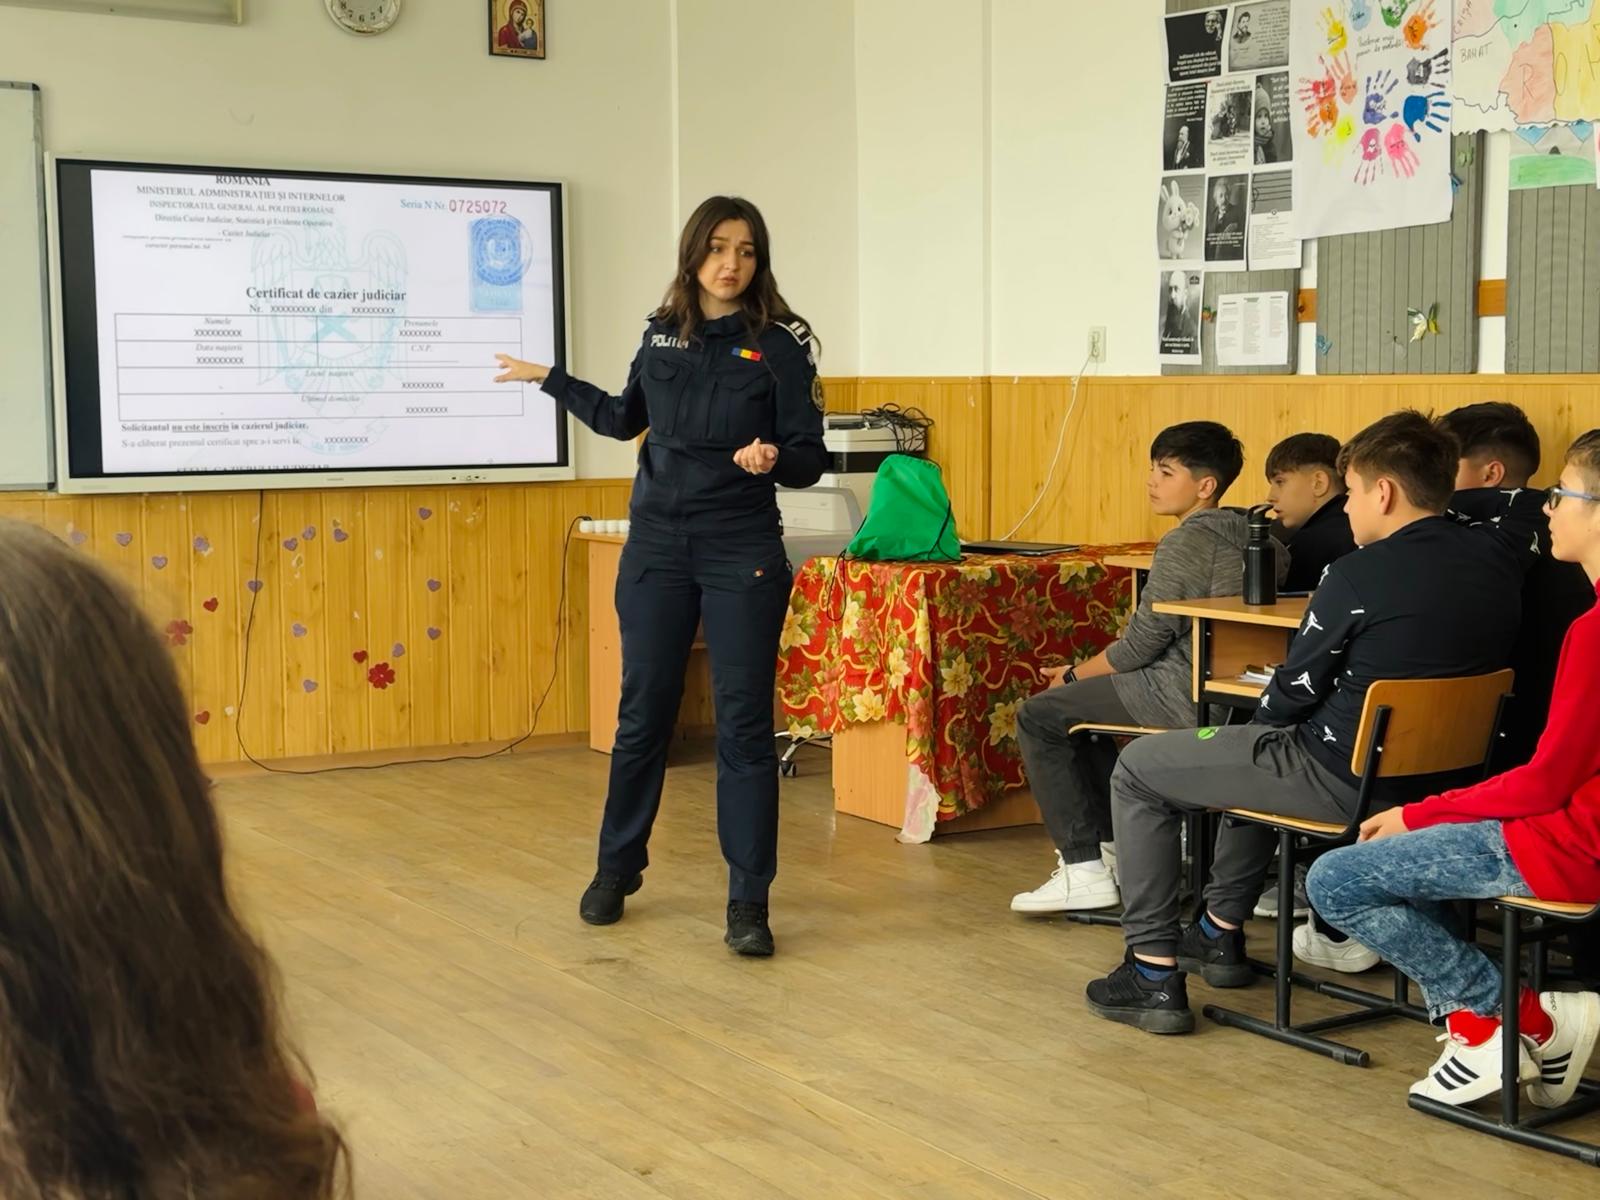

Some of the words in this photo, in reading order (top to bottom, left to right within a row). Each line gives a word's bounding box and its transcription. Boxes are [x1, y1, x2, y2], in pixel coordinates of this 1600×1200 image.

[136, 185, 196, 196] MINISTERUL
[288, 191, 346, 202] INTERNELOR
[217, 203, 253, 212] GENERAL
[399, 199, 422, 209] Seria
[448, 199, 508, 214] 0725072
[246, 286, 303, 299] Certificat
[306, 287, 321, 300] de
[323, 287, 359, 301] cazier
[360, 288, 407, 303] judiciar
[249, 303, 264, 314] Nr.
